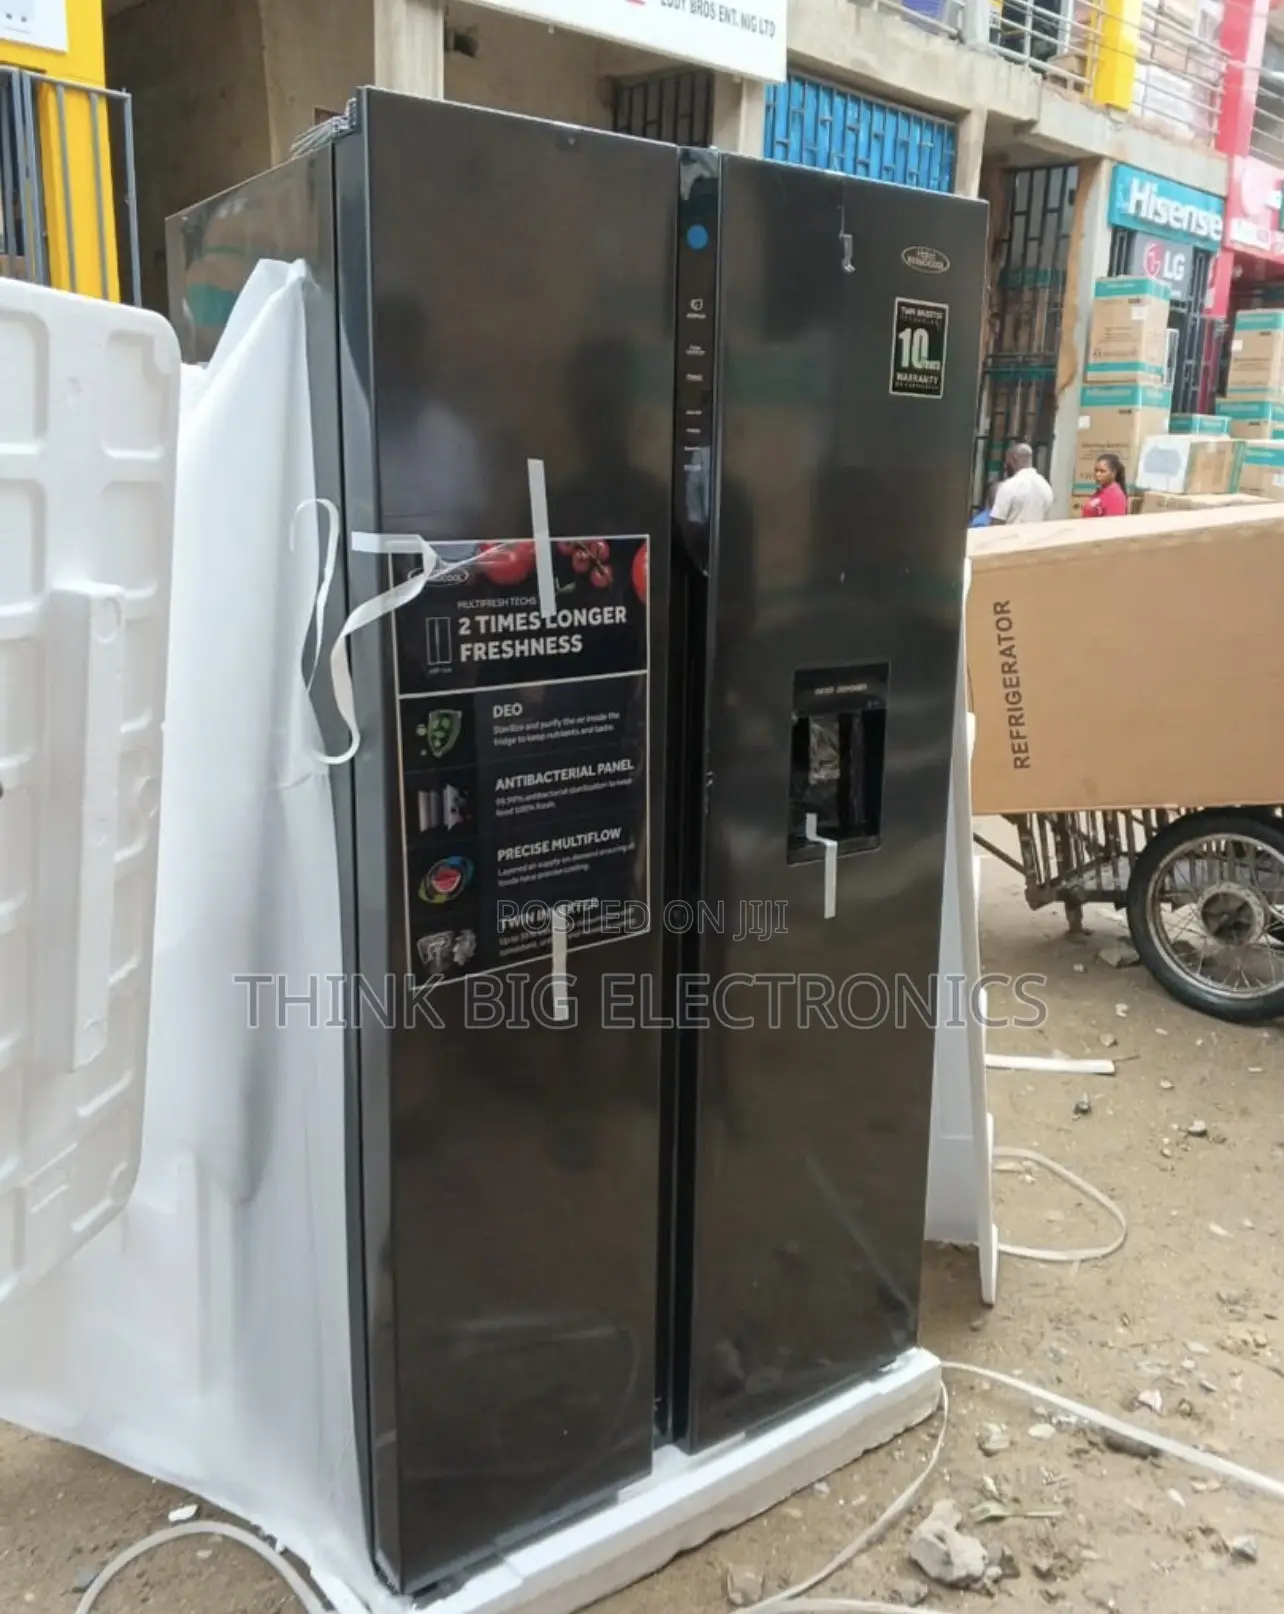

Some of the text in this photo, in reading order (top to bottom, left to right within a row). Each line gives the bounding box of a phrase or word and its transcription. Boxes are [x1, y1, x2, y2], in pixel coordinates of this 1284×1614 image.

[690, 0, 716, 20] BROS
[759, 16, 776, 38] LTD
[1128, 176, 1223, 241] Hisense
[1162, 250, 1186, 281] LG
[898, 328, 929, 369] 10
[459, 606, 627, 635] 2 TIMES LONGER
[460, 634, 583, 663] FRESHNESS
[993, 600, 1031, 770] REFRIGERATOR
[492, 702, 523, 718] DEO
[495, 765, 596, 791] ANTIBACTERIAL
[597, 759, 635, 775] PANEL
[497, 840, 550, 862] PRECISE
[551, 827, 622, 850] MULTIFLOW
